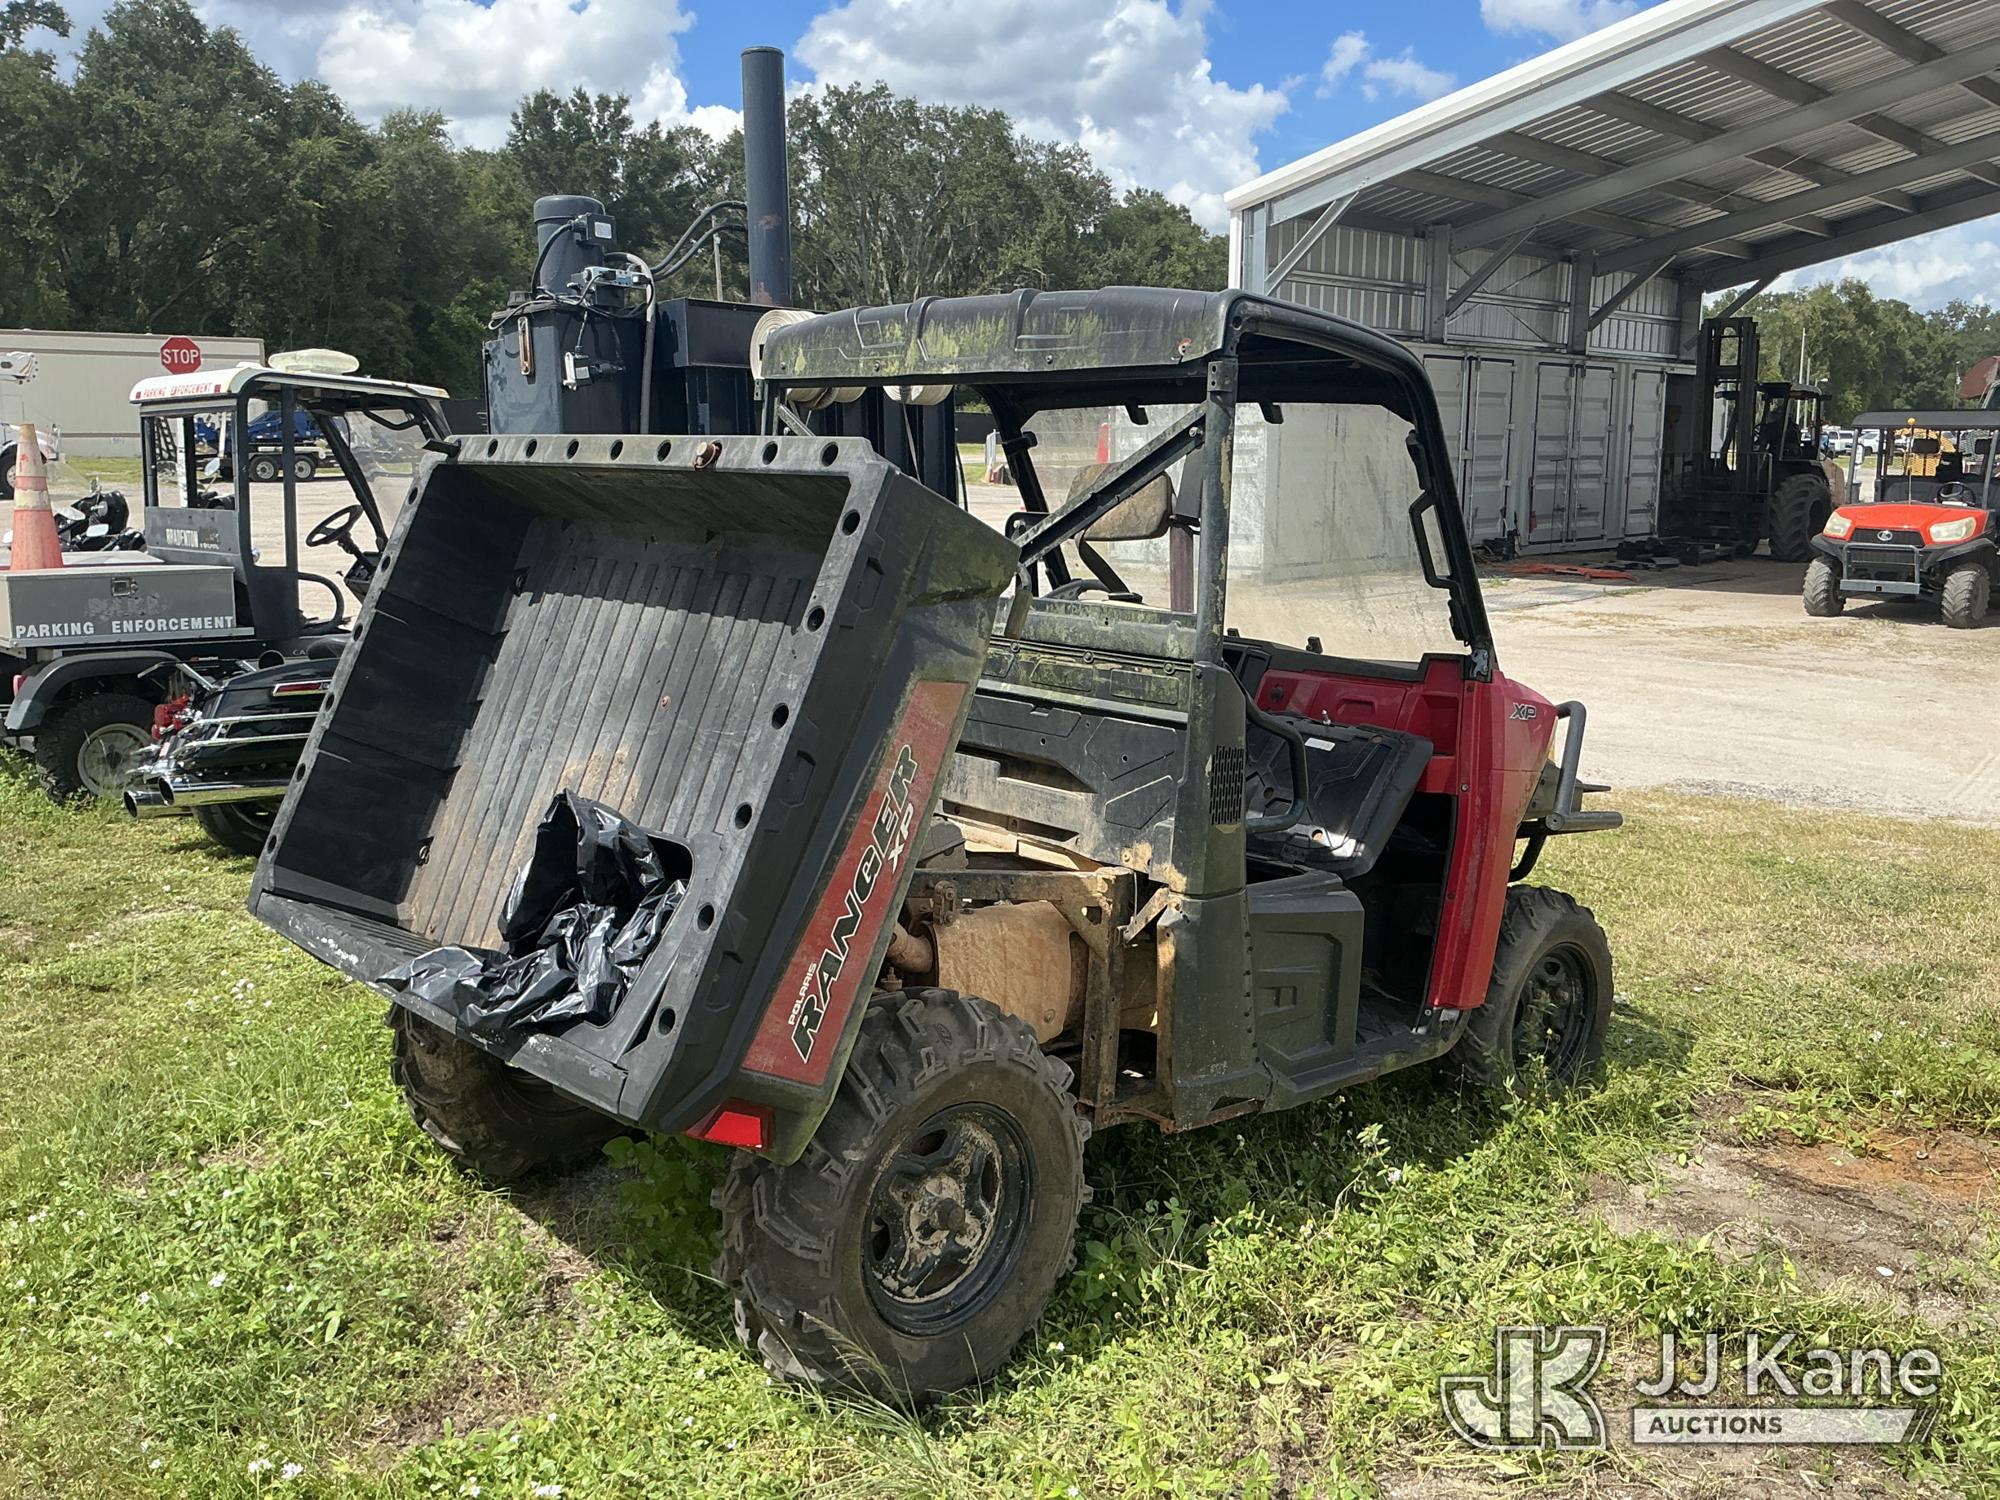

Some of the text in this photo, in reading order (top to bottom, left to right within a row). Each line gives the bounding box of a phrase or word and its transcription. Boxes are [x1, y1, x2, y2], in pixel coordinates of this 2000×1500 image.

[162, 348, 199, 364] STOP
[16, 616, 234, 638] PARKING ENFORCEMENT
[1509, 702, 1537, 720] XP
[888, 802, 914, 874] XP
[791, 744, 918, 1064] RANGER
[787, 962, 818, 1026] POLARIS
